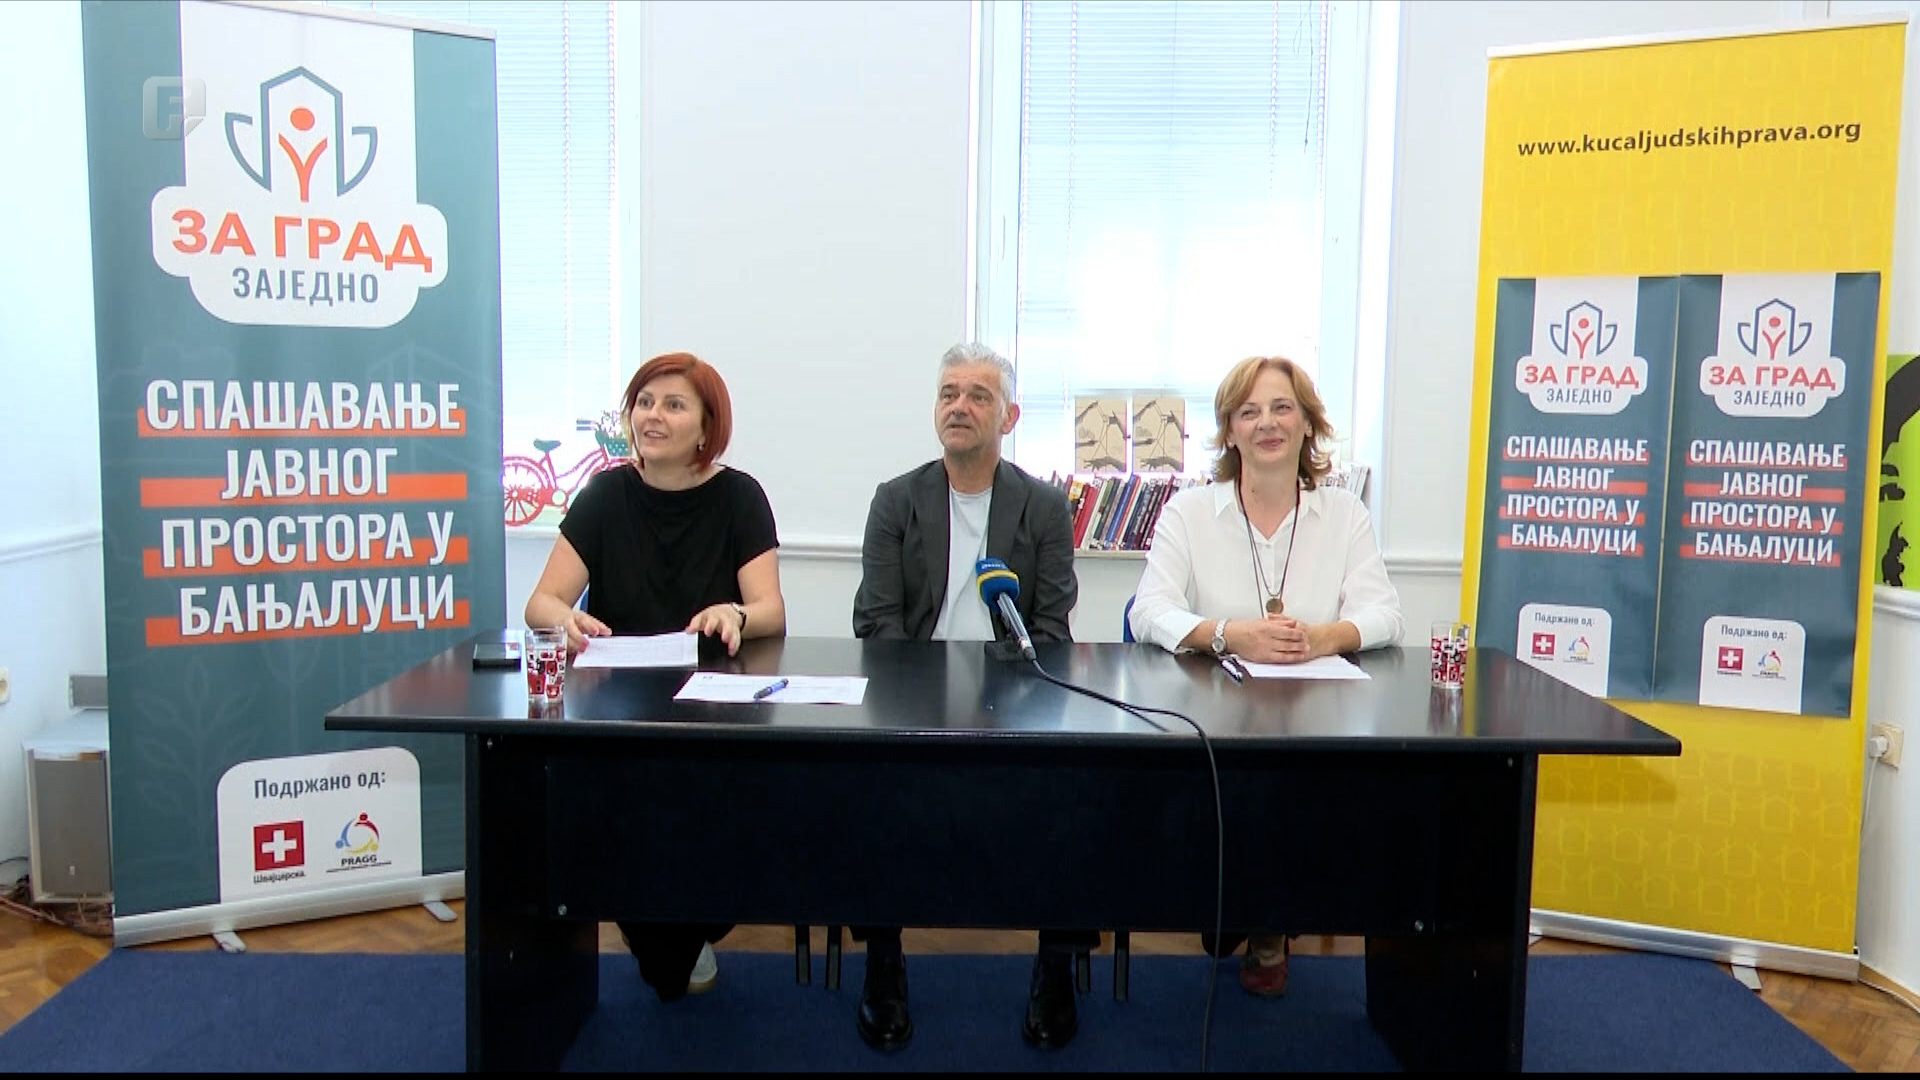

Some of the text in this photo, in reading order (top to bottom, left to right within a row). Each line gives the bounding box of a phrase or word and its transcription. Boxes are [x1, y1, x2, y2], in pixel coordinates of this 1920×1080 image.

[1517, 122, 1861, 156] www.kucaljudskihprava.org
[171, 209, 432, 273] ЗА ГРАД
[232, 267, 379, 306] ЗАЈЕДНО
[1524, 365, 1639, 388] ЗА ГРАД
[1709, 366, 1836, 390] ЗА ГРАД
[146, 379, 461, 430] СПАШАВАЊЕ
[1546, 388, 1612, 405] ЗАЈЕДНО
[1733, 390, 1806, 408] ЗАЈЕДНО
[1507, 435, 1648, 462] СПАШАВАЊЕ
[1690, 439, 1846, 468] СПАШАВАЊЕ
[221, 447, 398, 500] ЈАВНОГ
[1533, 466, 1614, 491] ЈАВНОГ
[1719, 472, 1808, 498] ЈАВНОГ
[1506, 494, 1640, 525] ПРОСТОРА У
[1690, 501, 1837, 535] ПРОСТОРА У
[161, 511, 455, 568] ПРОСТОРА У
[1511, 524, 1637, 555] БАЊАЛУЦИ
[1695, 532, 1833, 565] БАЊАЛУЦИ
[180, 574, 455, 636] БАЊАЛУЦИ
[1721, 624, 1770, 638] Подржано
[254, 770, 387, 799] Подржано од:
[341, 854, 378, 867] PRAGG
[253, 870, 305, 884] Швајцарска
